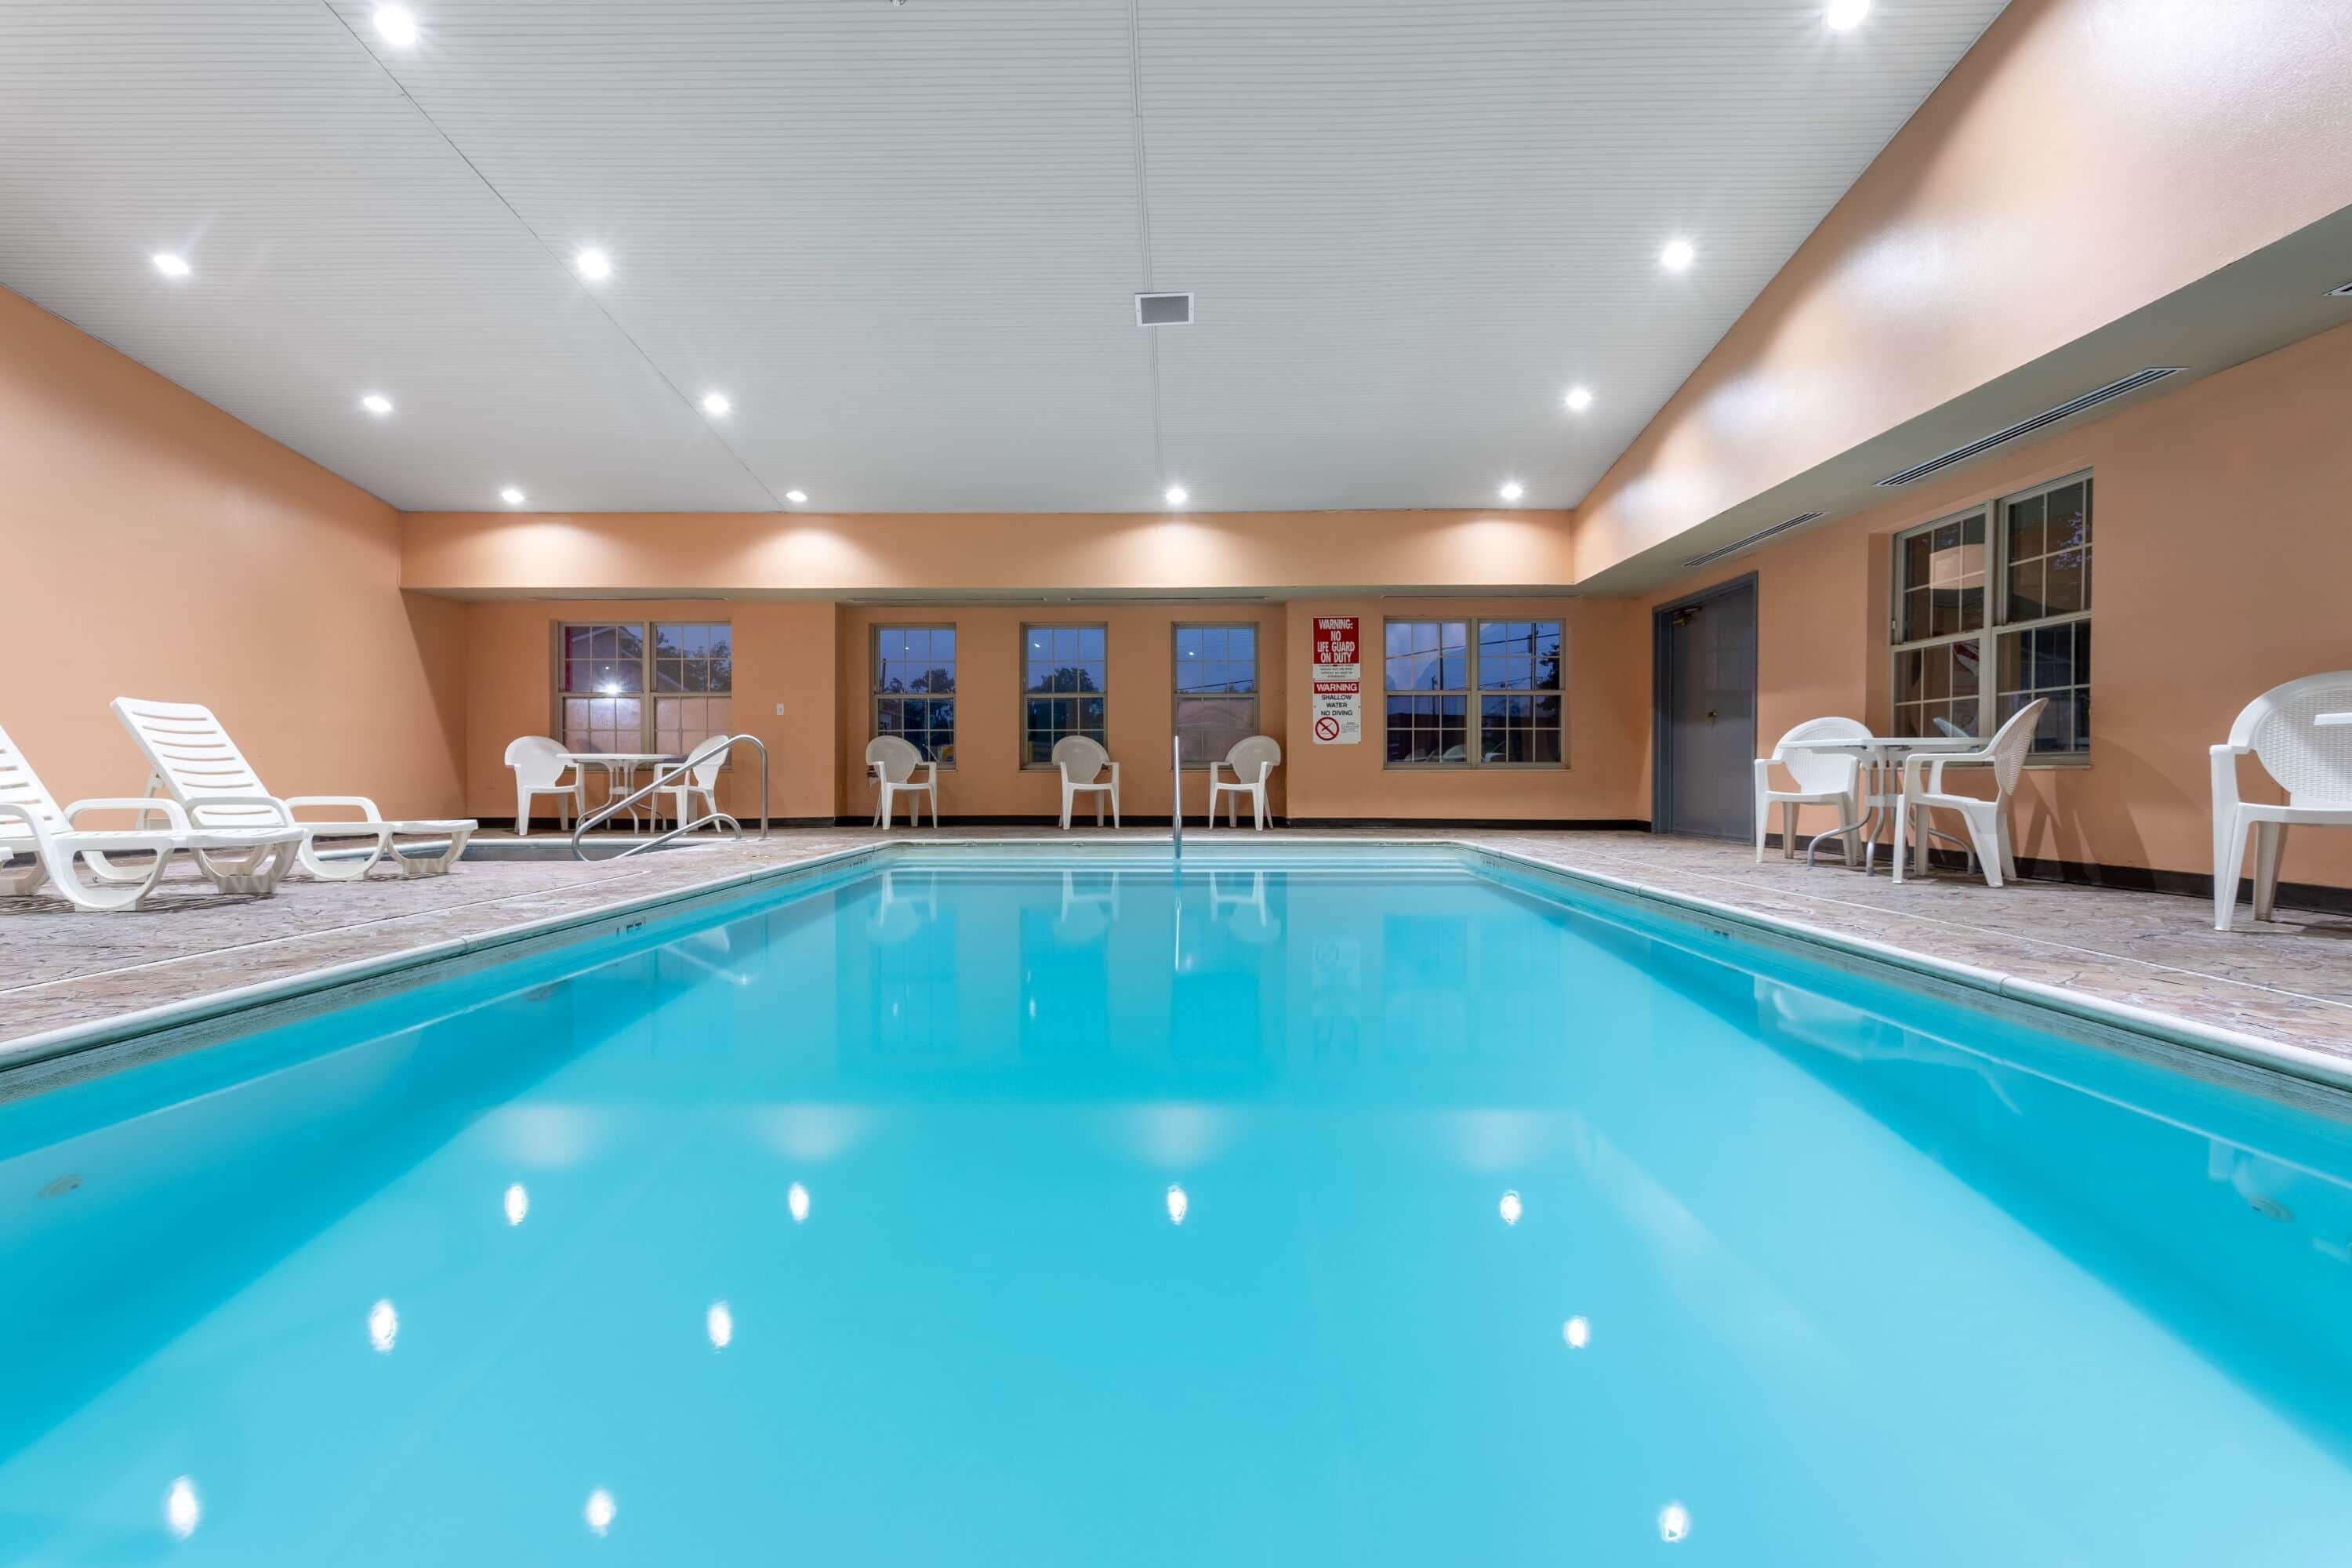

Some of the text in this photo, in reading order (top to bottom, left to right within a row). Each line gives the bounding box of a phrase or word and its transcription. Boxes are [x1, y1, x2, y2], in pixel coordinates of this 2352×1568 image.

[1319, 619, 1353, 630] WARNING:
[1330, 630, 1341, 641] NO
[1317, 641, 1355, 652] LIFE GUARD
[1320, 652, 1352, 662] ON DUTY
[1317, 683, 1357, 691] WARNING
